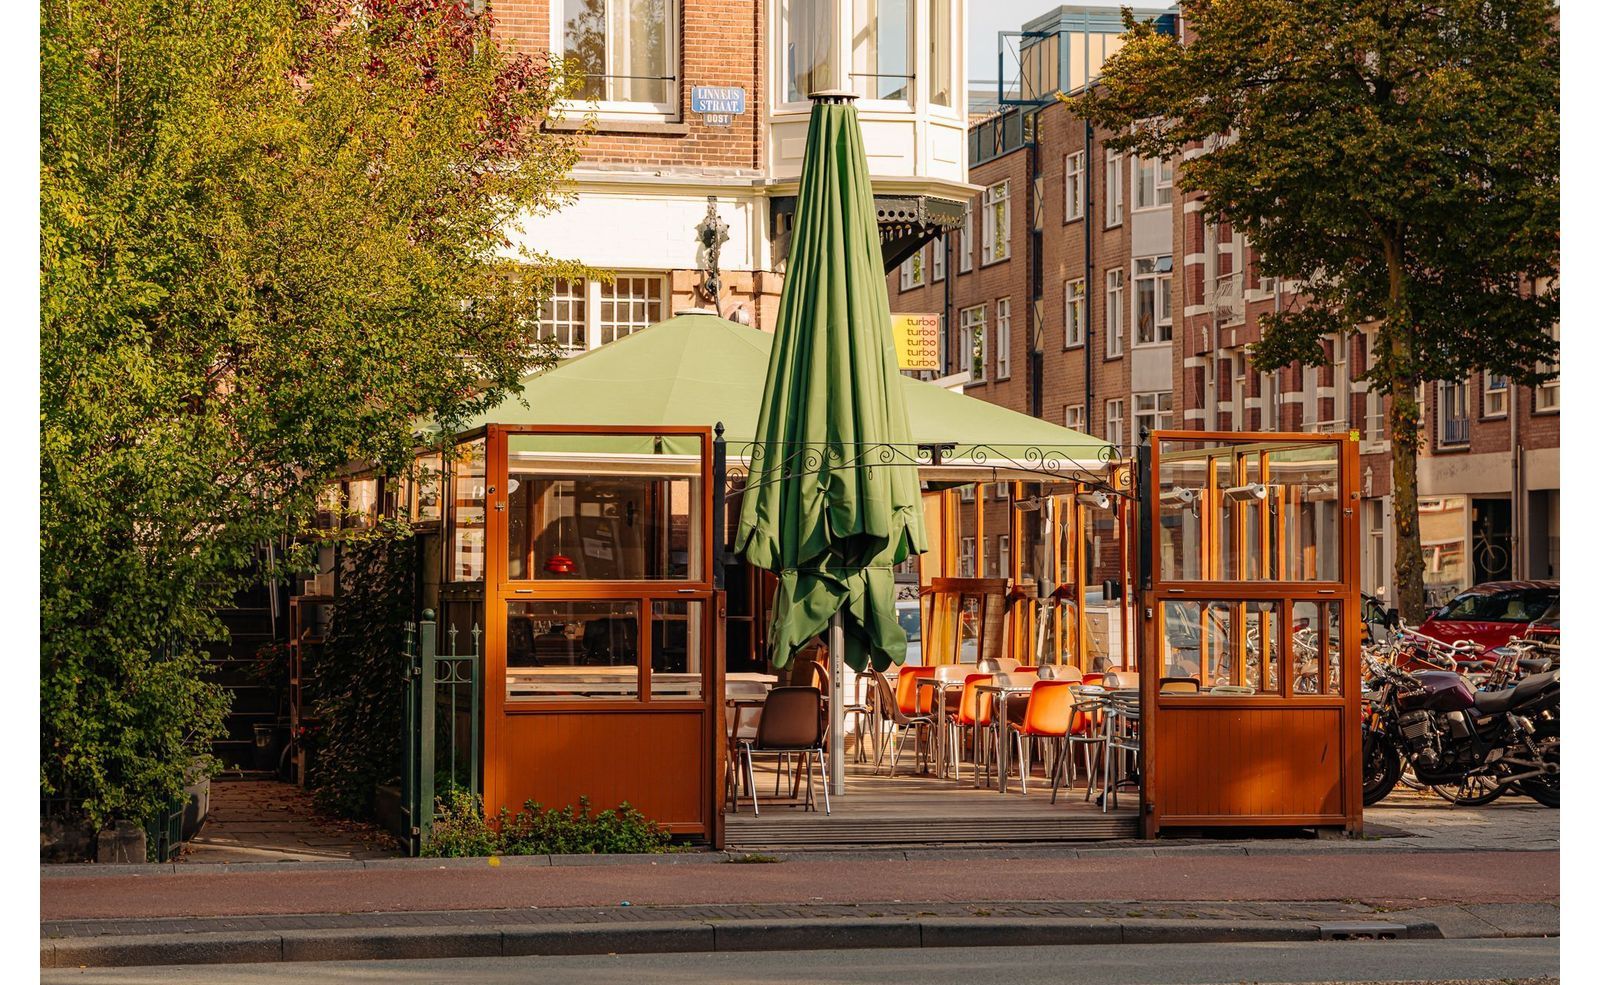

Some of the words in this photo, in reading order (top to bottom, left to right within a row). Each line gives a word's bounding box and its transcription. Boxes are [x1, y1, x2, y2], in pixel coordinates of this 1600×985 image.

[707, 114, 728, 123] OOST
[907, 317, 936, 326] turbo
[907, 327, 936, 336] turbo
[907, 337, 936, 346] turbo
[907, 347, 936, 357] turbo
[907, 357, 936, 367] turbo
